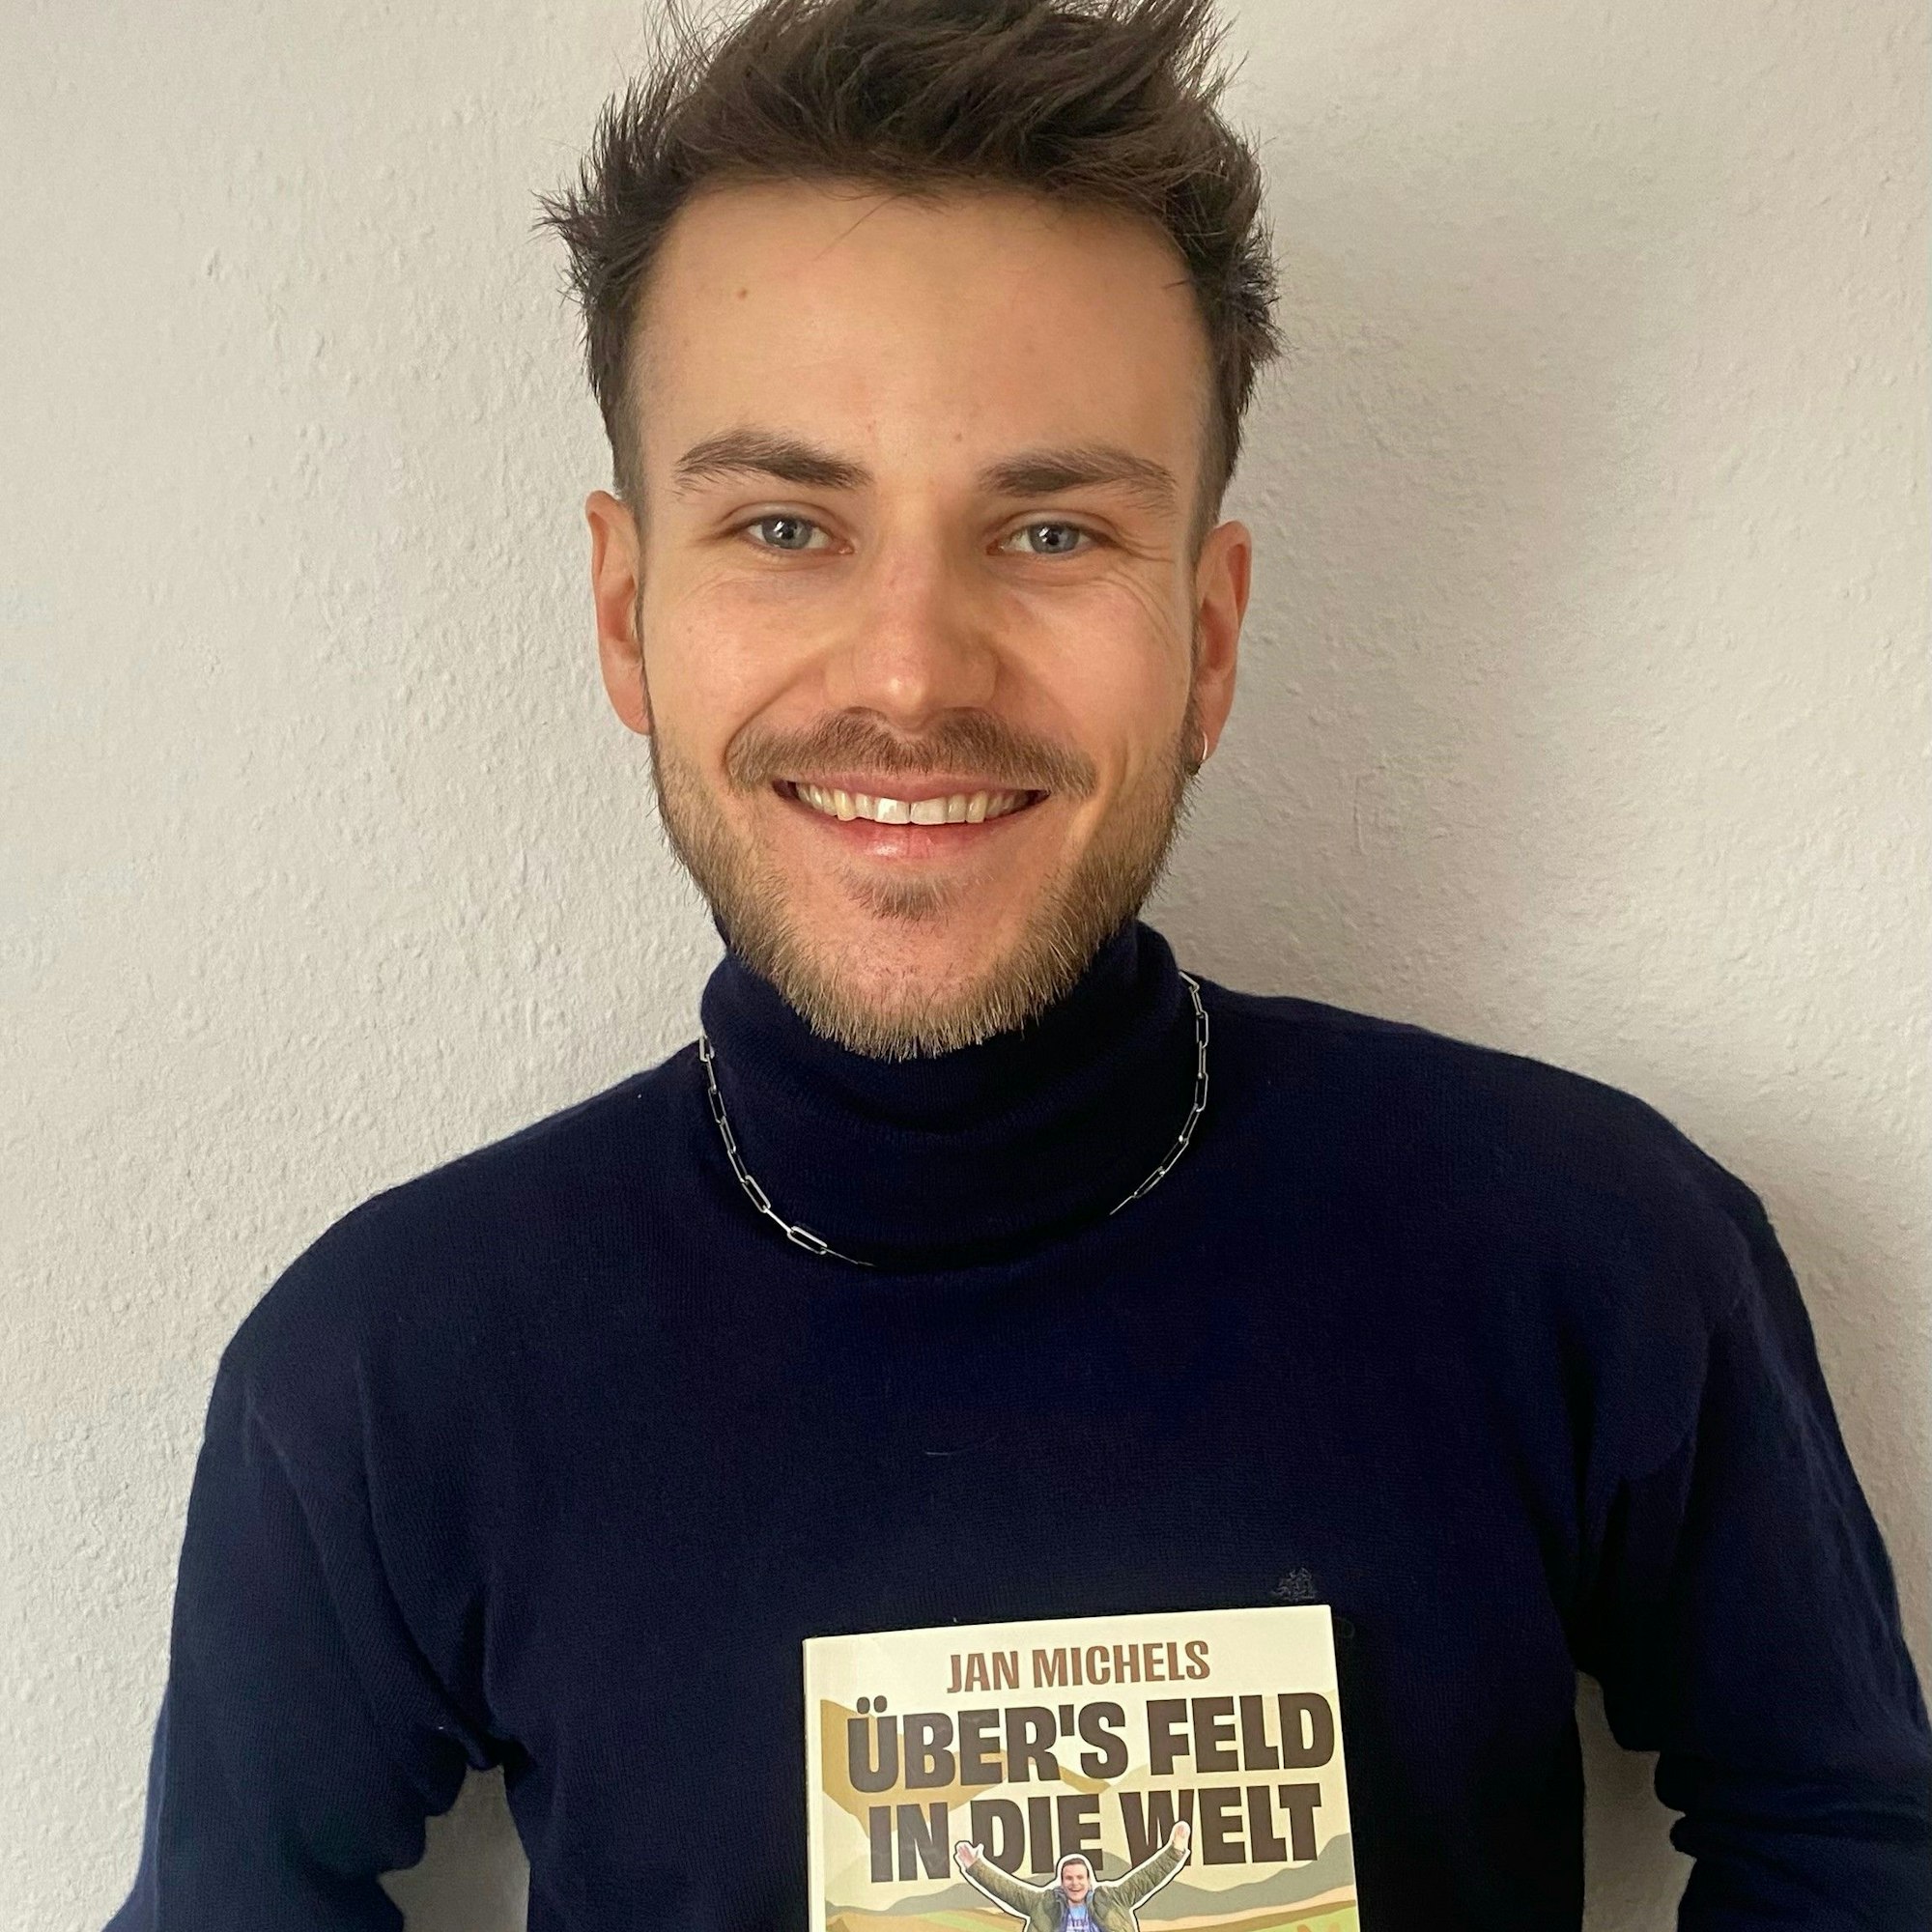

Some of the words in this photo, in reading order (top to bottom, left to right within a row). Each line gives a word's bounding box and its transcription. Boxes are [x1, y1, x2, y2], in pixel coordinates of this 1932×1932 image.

[947, 1651, 1020, 1693] JAN
[1032, 1640, 1210, 1689] MICHELS
[846, 1695, 1129, 1794] ÜBER'S
[1146, 1691, 1335, 1776] FELD
[868, 1802, 952, 1884] IN
[969, 1794, 1105, 1876] DIE
[1118, 1783, 1322, 1869] WELT
